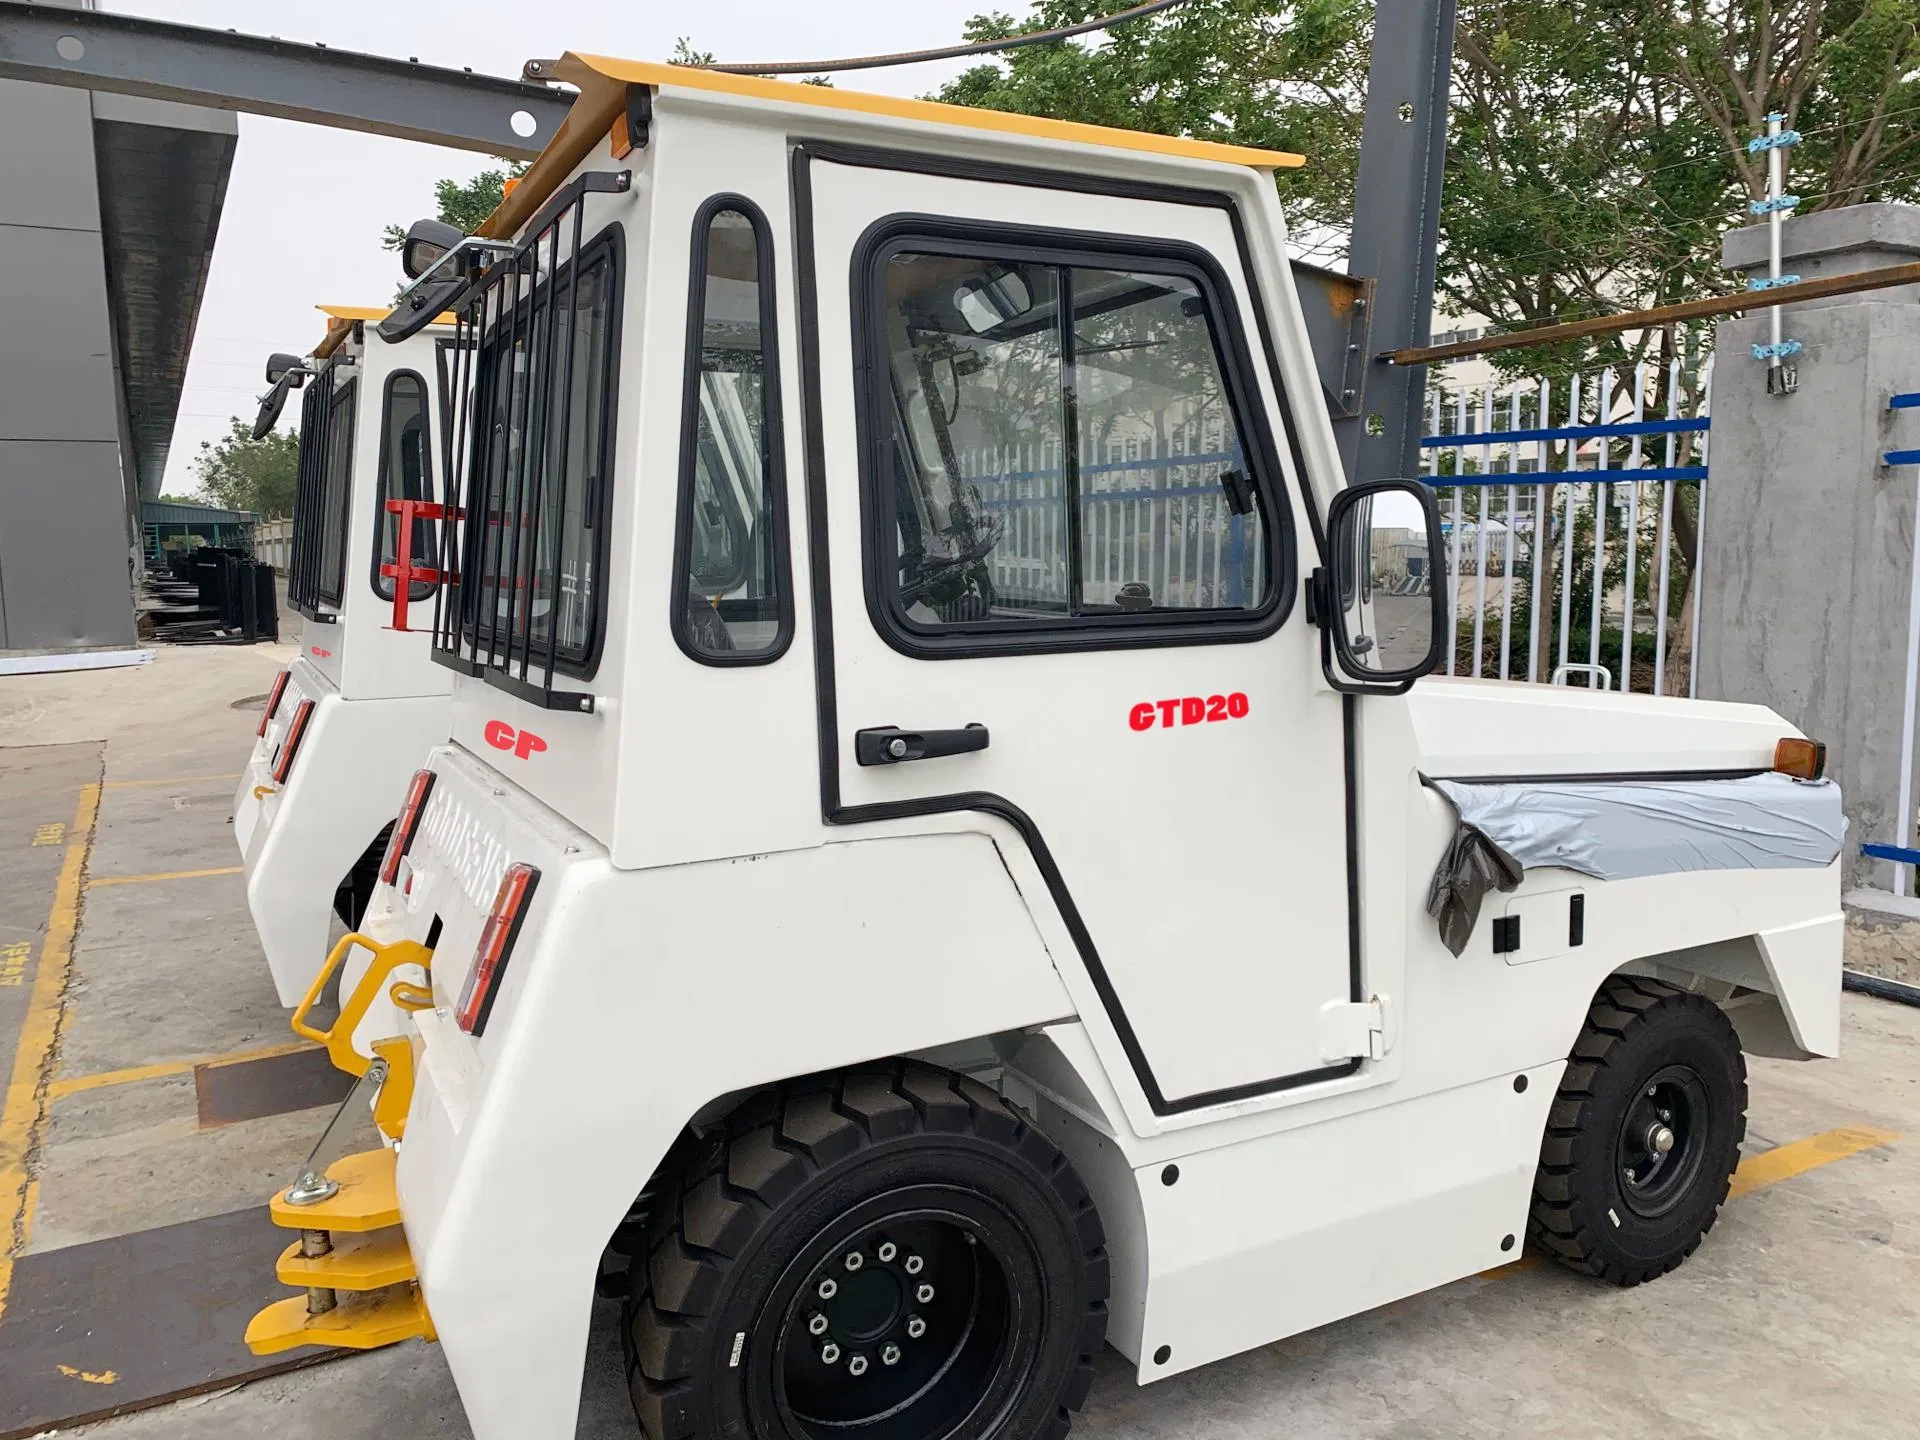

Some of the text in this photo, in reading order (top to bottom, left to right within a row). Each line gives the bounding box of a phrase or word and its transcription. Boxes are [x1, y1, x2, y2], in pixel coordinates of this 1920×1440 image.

[311, 646, 331, 658] GP
[1129, 692, 1250, 732] GTD20
[484, 720, 548, 761] GP
